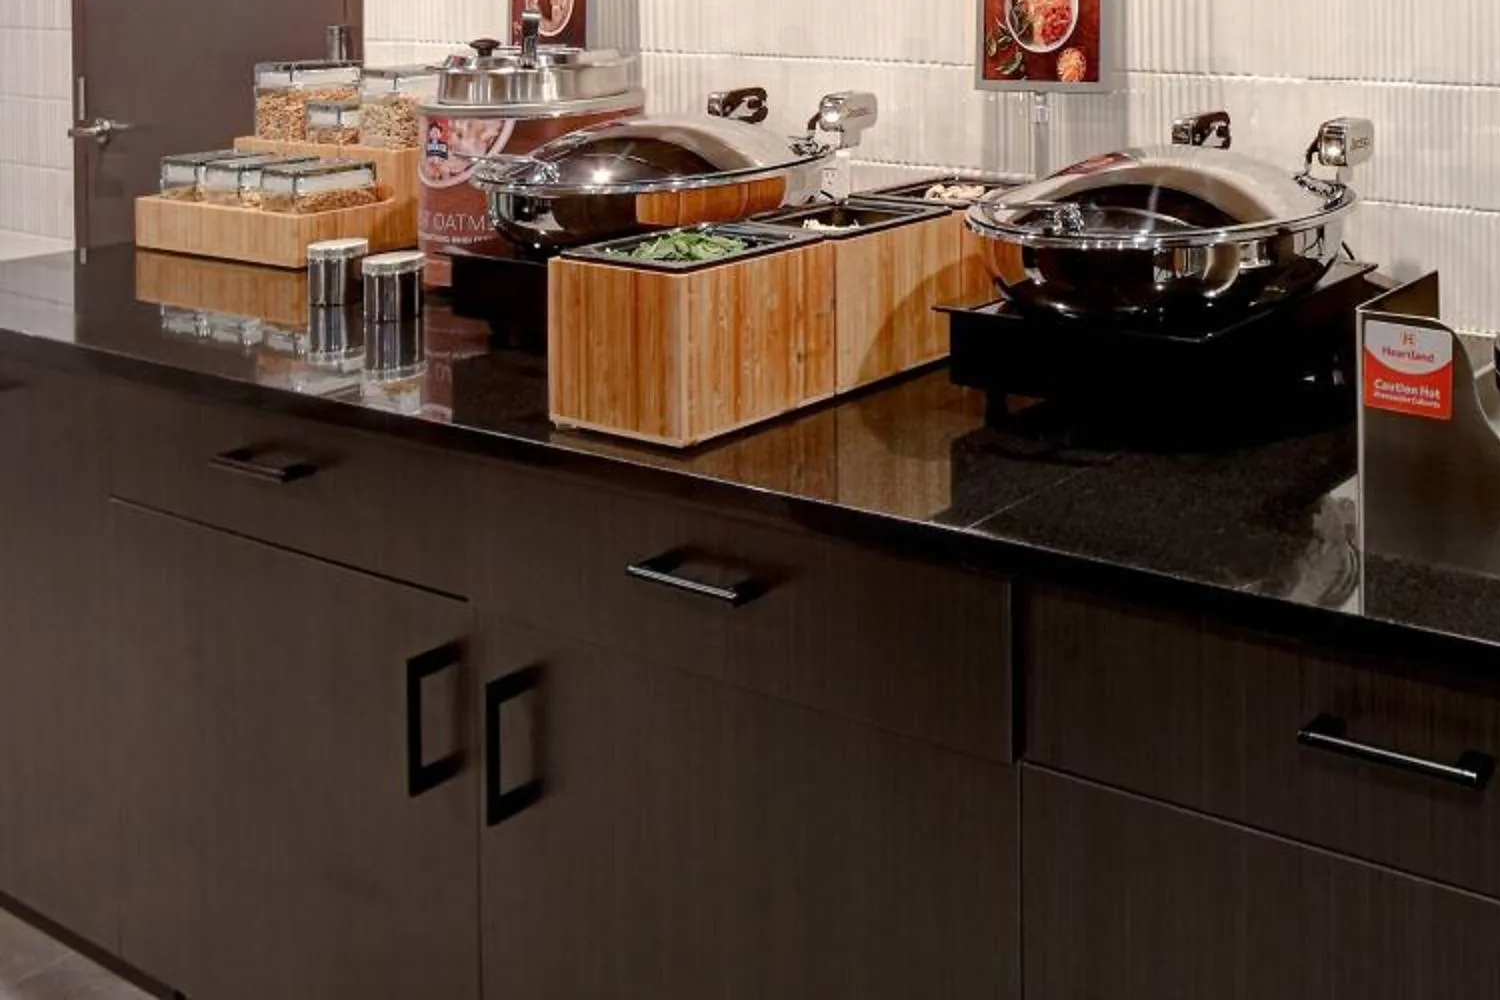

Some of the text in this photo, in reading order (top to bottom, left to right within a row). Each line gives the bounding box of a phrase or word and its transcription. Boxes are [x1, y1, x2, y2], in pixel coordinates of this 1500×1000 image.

[1381, 347, 1435, 363] Heartland
[1374, 378, 1418, 395] Caution
[1419, 385, 1441, 400] Hot
